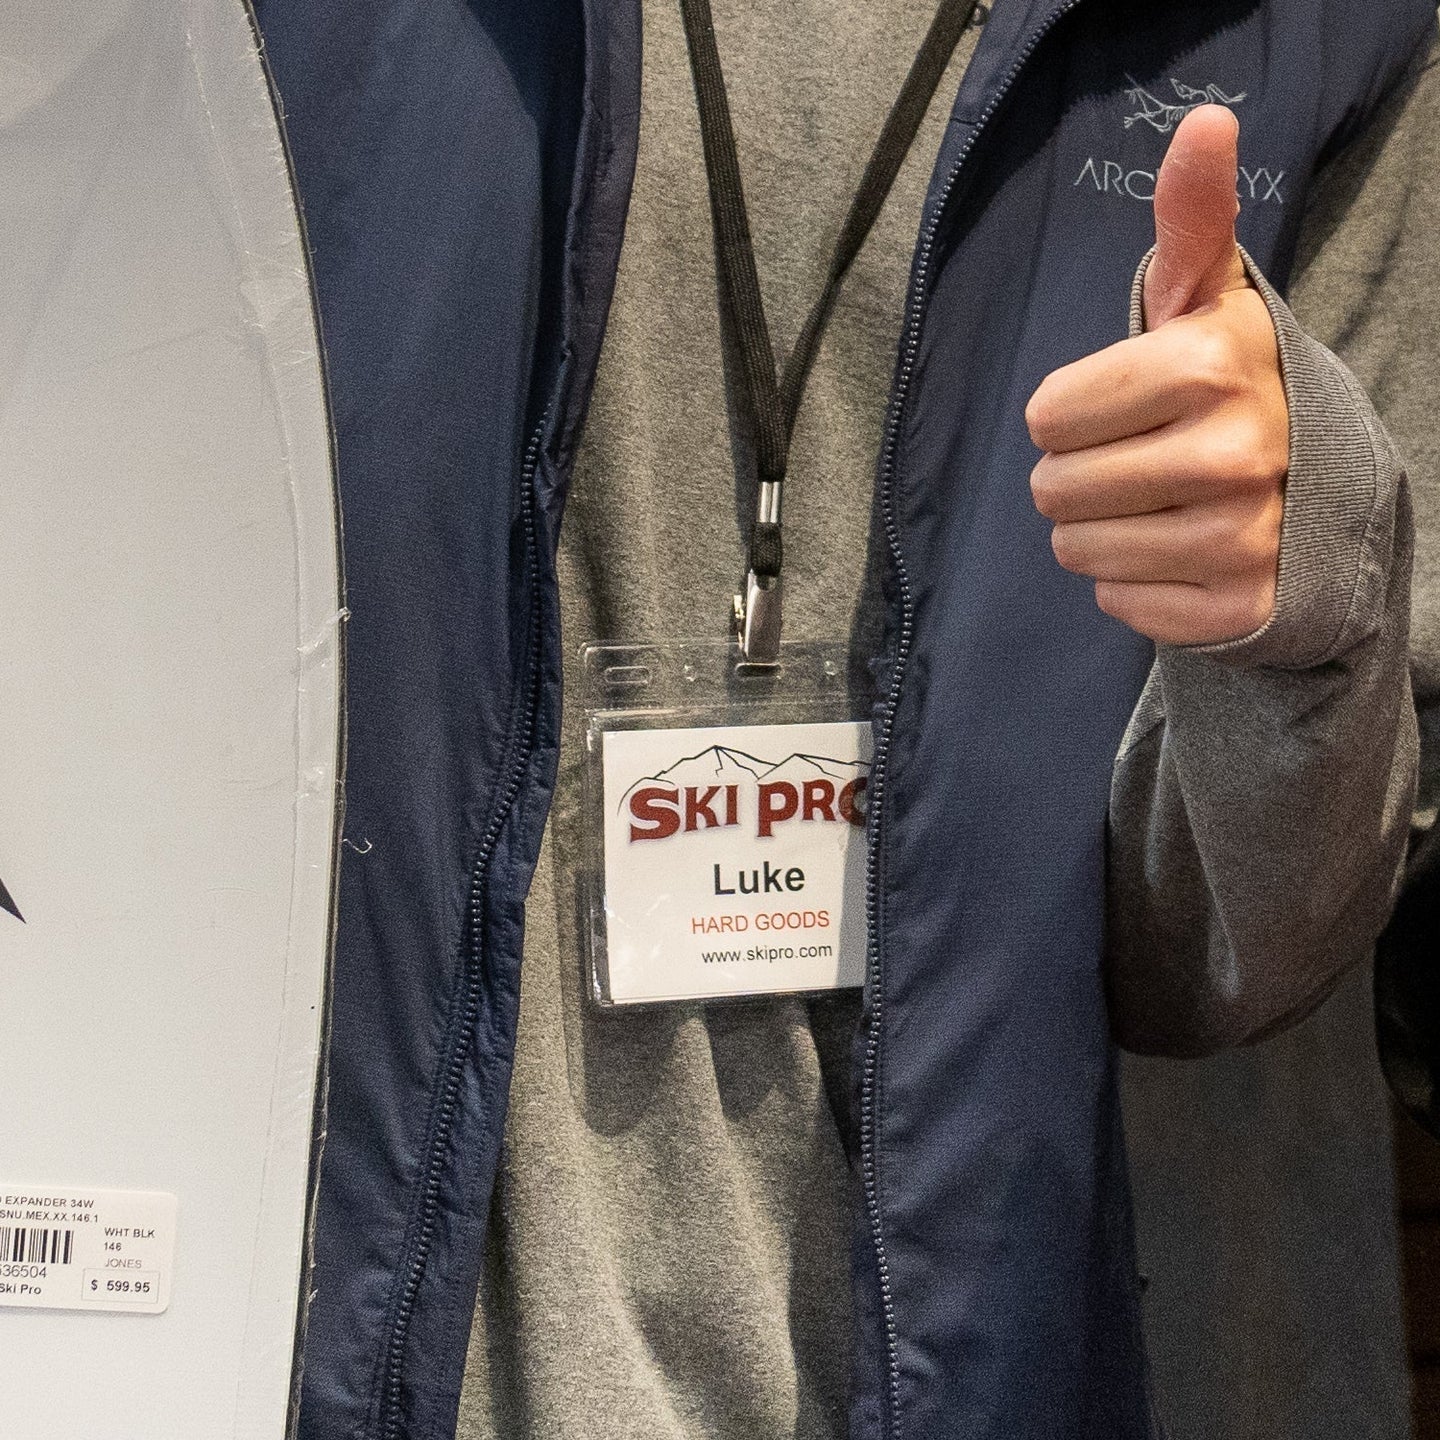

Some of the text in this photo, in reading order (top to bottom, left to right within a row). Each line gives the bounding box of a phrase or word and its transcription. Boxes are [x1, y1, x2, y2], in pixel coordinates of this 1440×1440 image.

[630, 784, 739, 844] SKI
[714, 862, 806, 896] Luke
[691, 910, 830, 935] HARD GOODS
[701, 944, 833, 964] www.skipro.com
[5, 1196, 67, 1207] EXPANDER
[70, 1199, 94, 1209] 34W
[104, 1228, 156, 1239] WHT BLK
[104, 1242, 122, 1251] 146
[104, 1258, 142, 1268] JONES
[21, 1284, 42, 1295] Pro
[106, 1281, 151, 1293] 599.95
